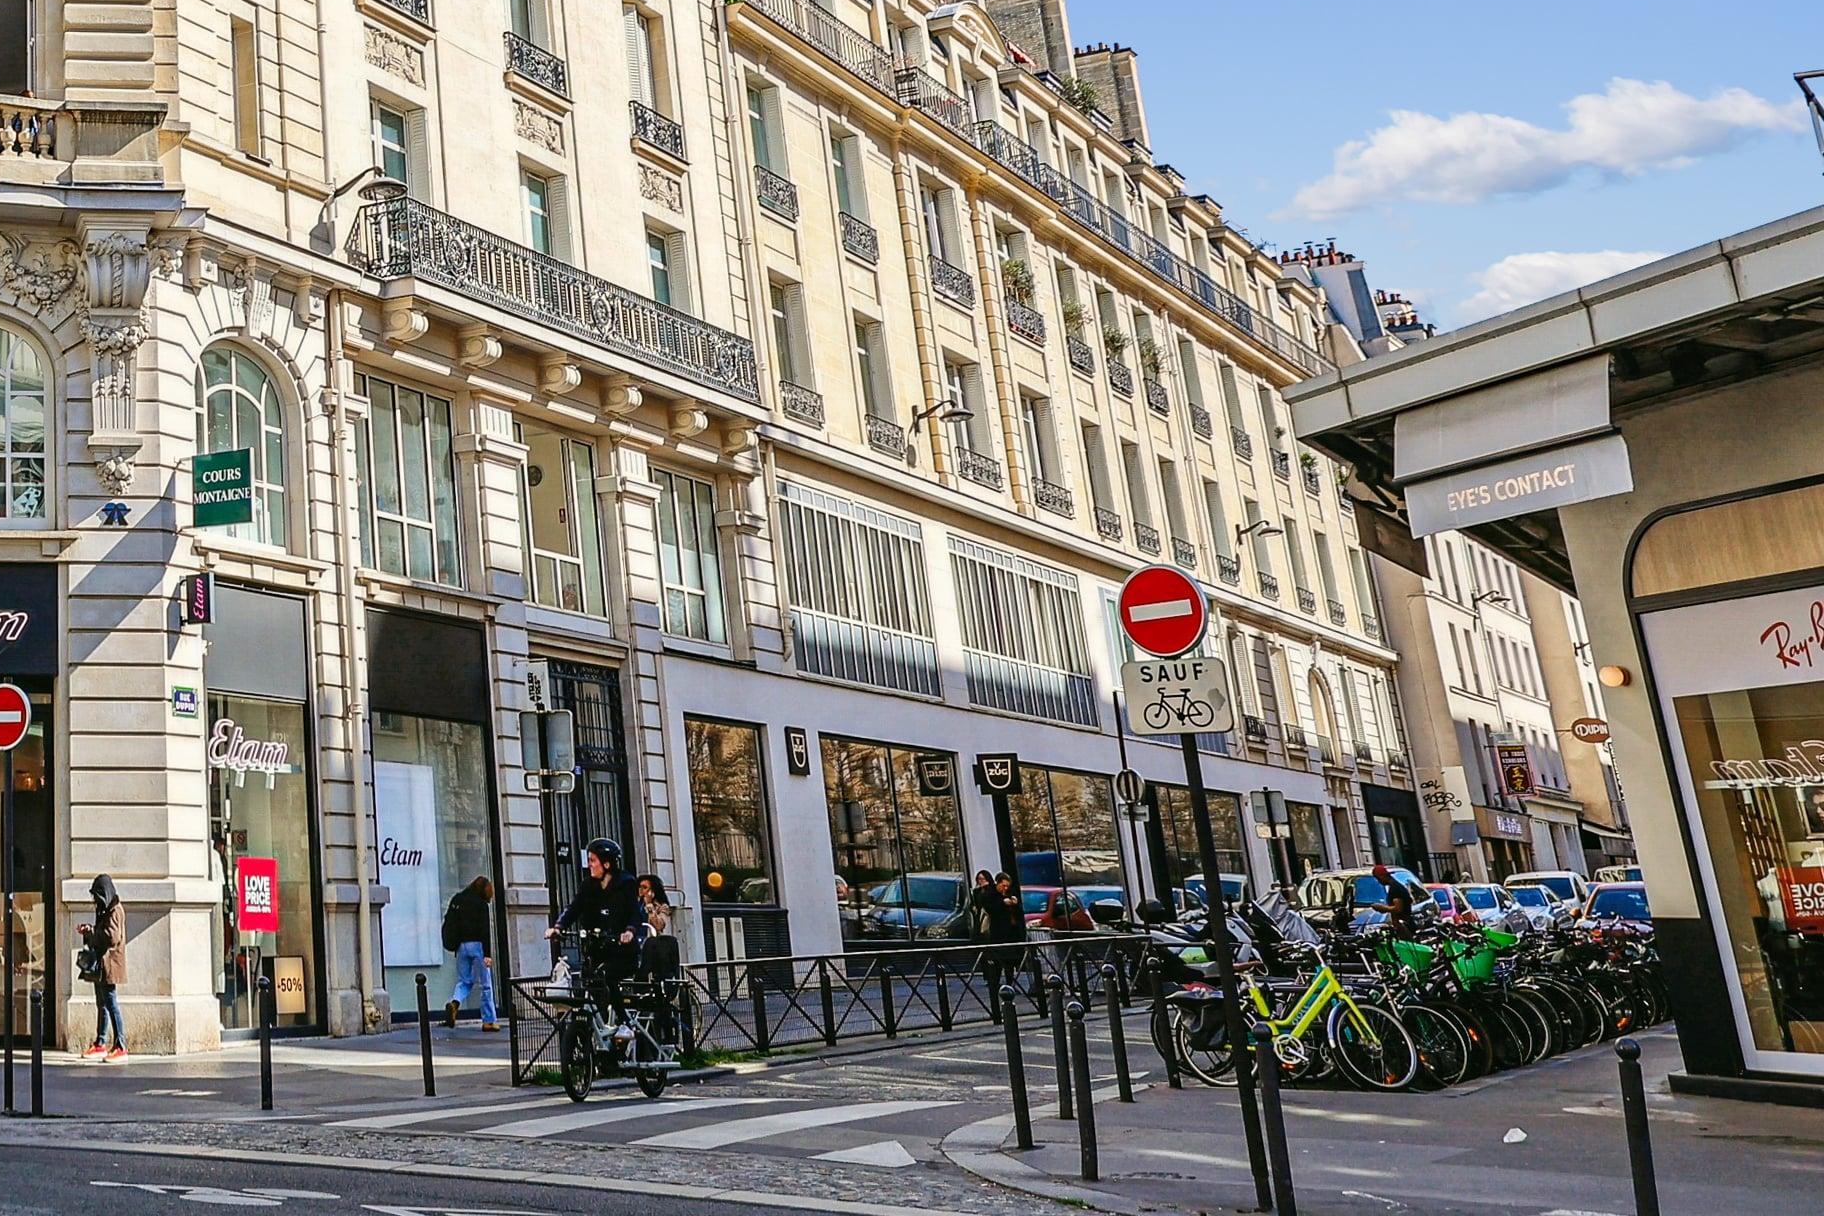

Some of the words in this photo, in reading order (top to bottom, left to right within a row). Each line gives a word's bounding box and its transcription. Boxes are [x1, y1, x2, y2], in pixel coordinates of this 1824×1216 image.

[202, 467, 242, 484] COURS
[193, 487, 252, 505] MONTAIGNE
[1447, 485, 1492, 512] EYE'S
[1494, 464, 1575, 501] CONTACT
[193, 577, 205, 620] Etam
[1140, 662, 1204, 683] SAUF
[1574, 724, 1608, 737] DUPIN
[208, 718, 288, 768] Etam
[380, 837, 422, 866] Etam
[244, 875, 270, 892] LOVE
[245, 891, 271, 905] PRICE
[277, 978, 303, 992] -50%
